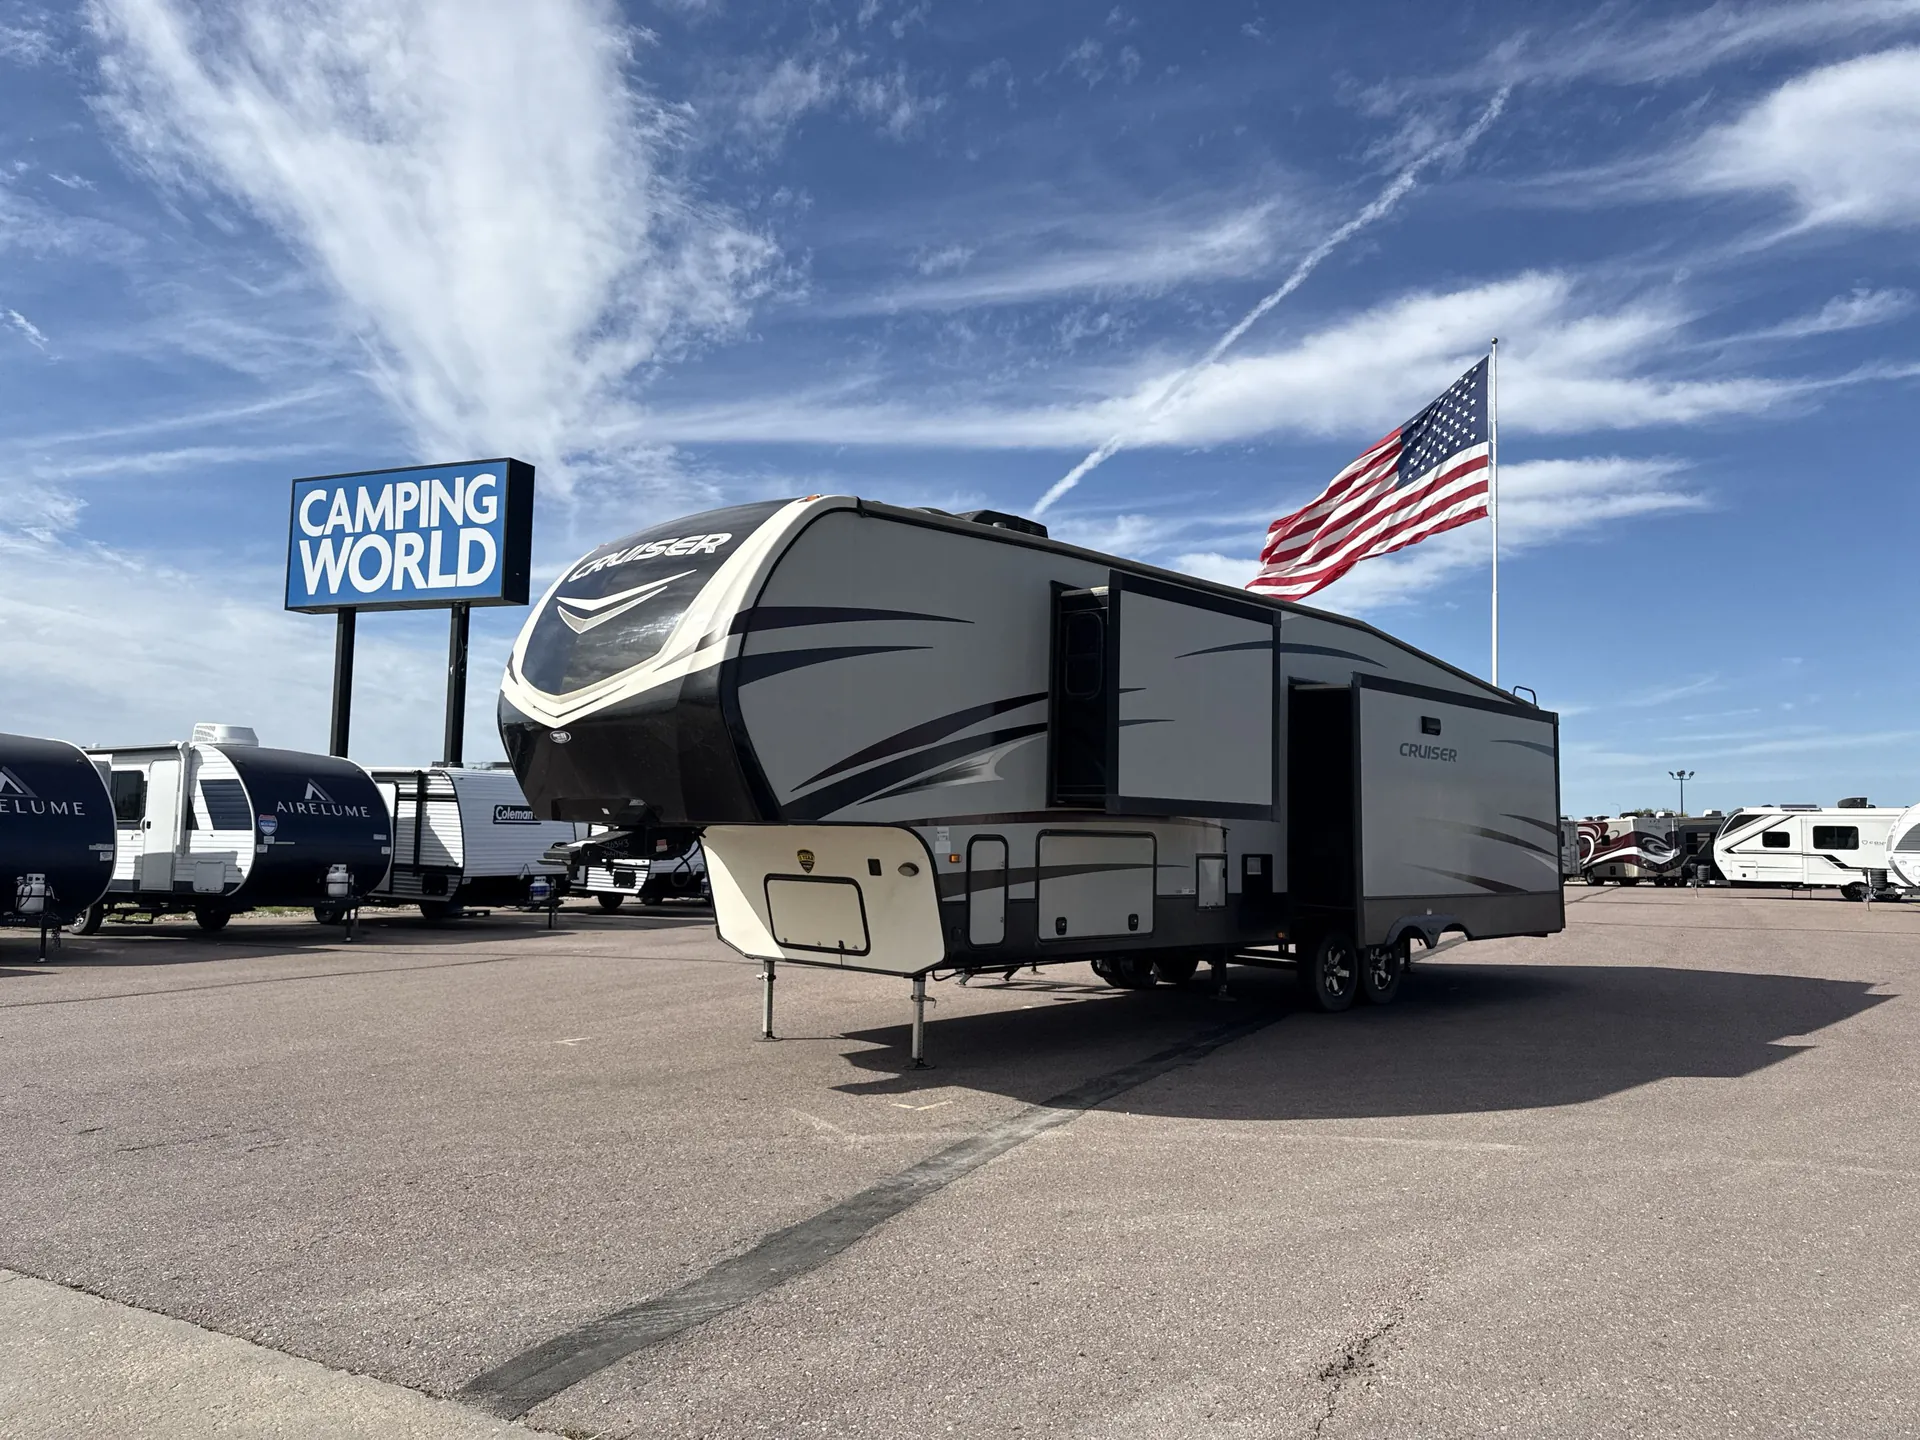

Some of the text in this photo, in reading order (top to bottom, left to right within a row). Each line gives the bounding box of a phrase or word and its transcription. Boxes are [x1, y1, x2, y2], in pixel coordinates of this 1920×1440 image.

[299, 474, 497, 537] CAMPING
[299, 527, 496, 595] WORLD
[568, 533, 732, 582] CRUISER
[1400, 743, 1457, 762] CRUISER
[277, 801, 371, 818] AIRELUME
[496, 806, 534, 820] Coleman
